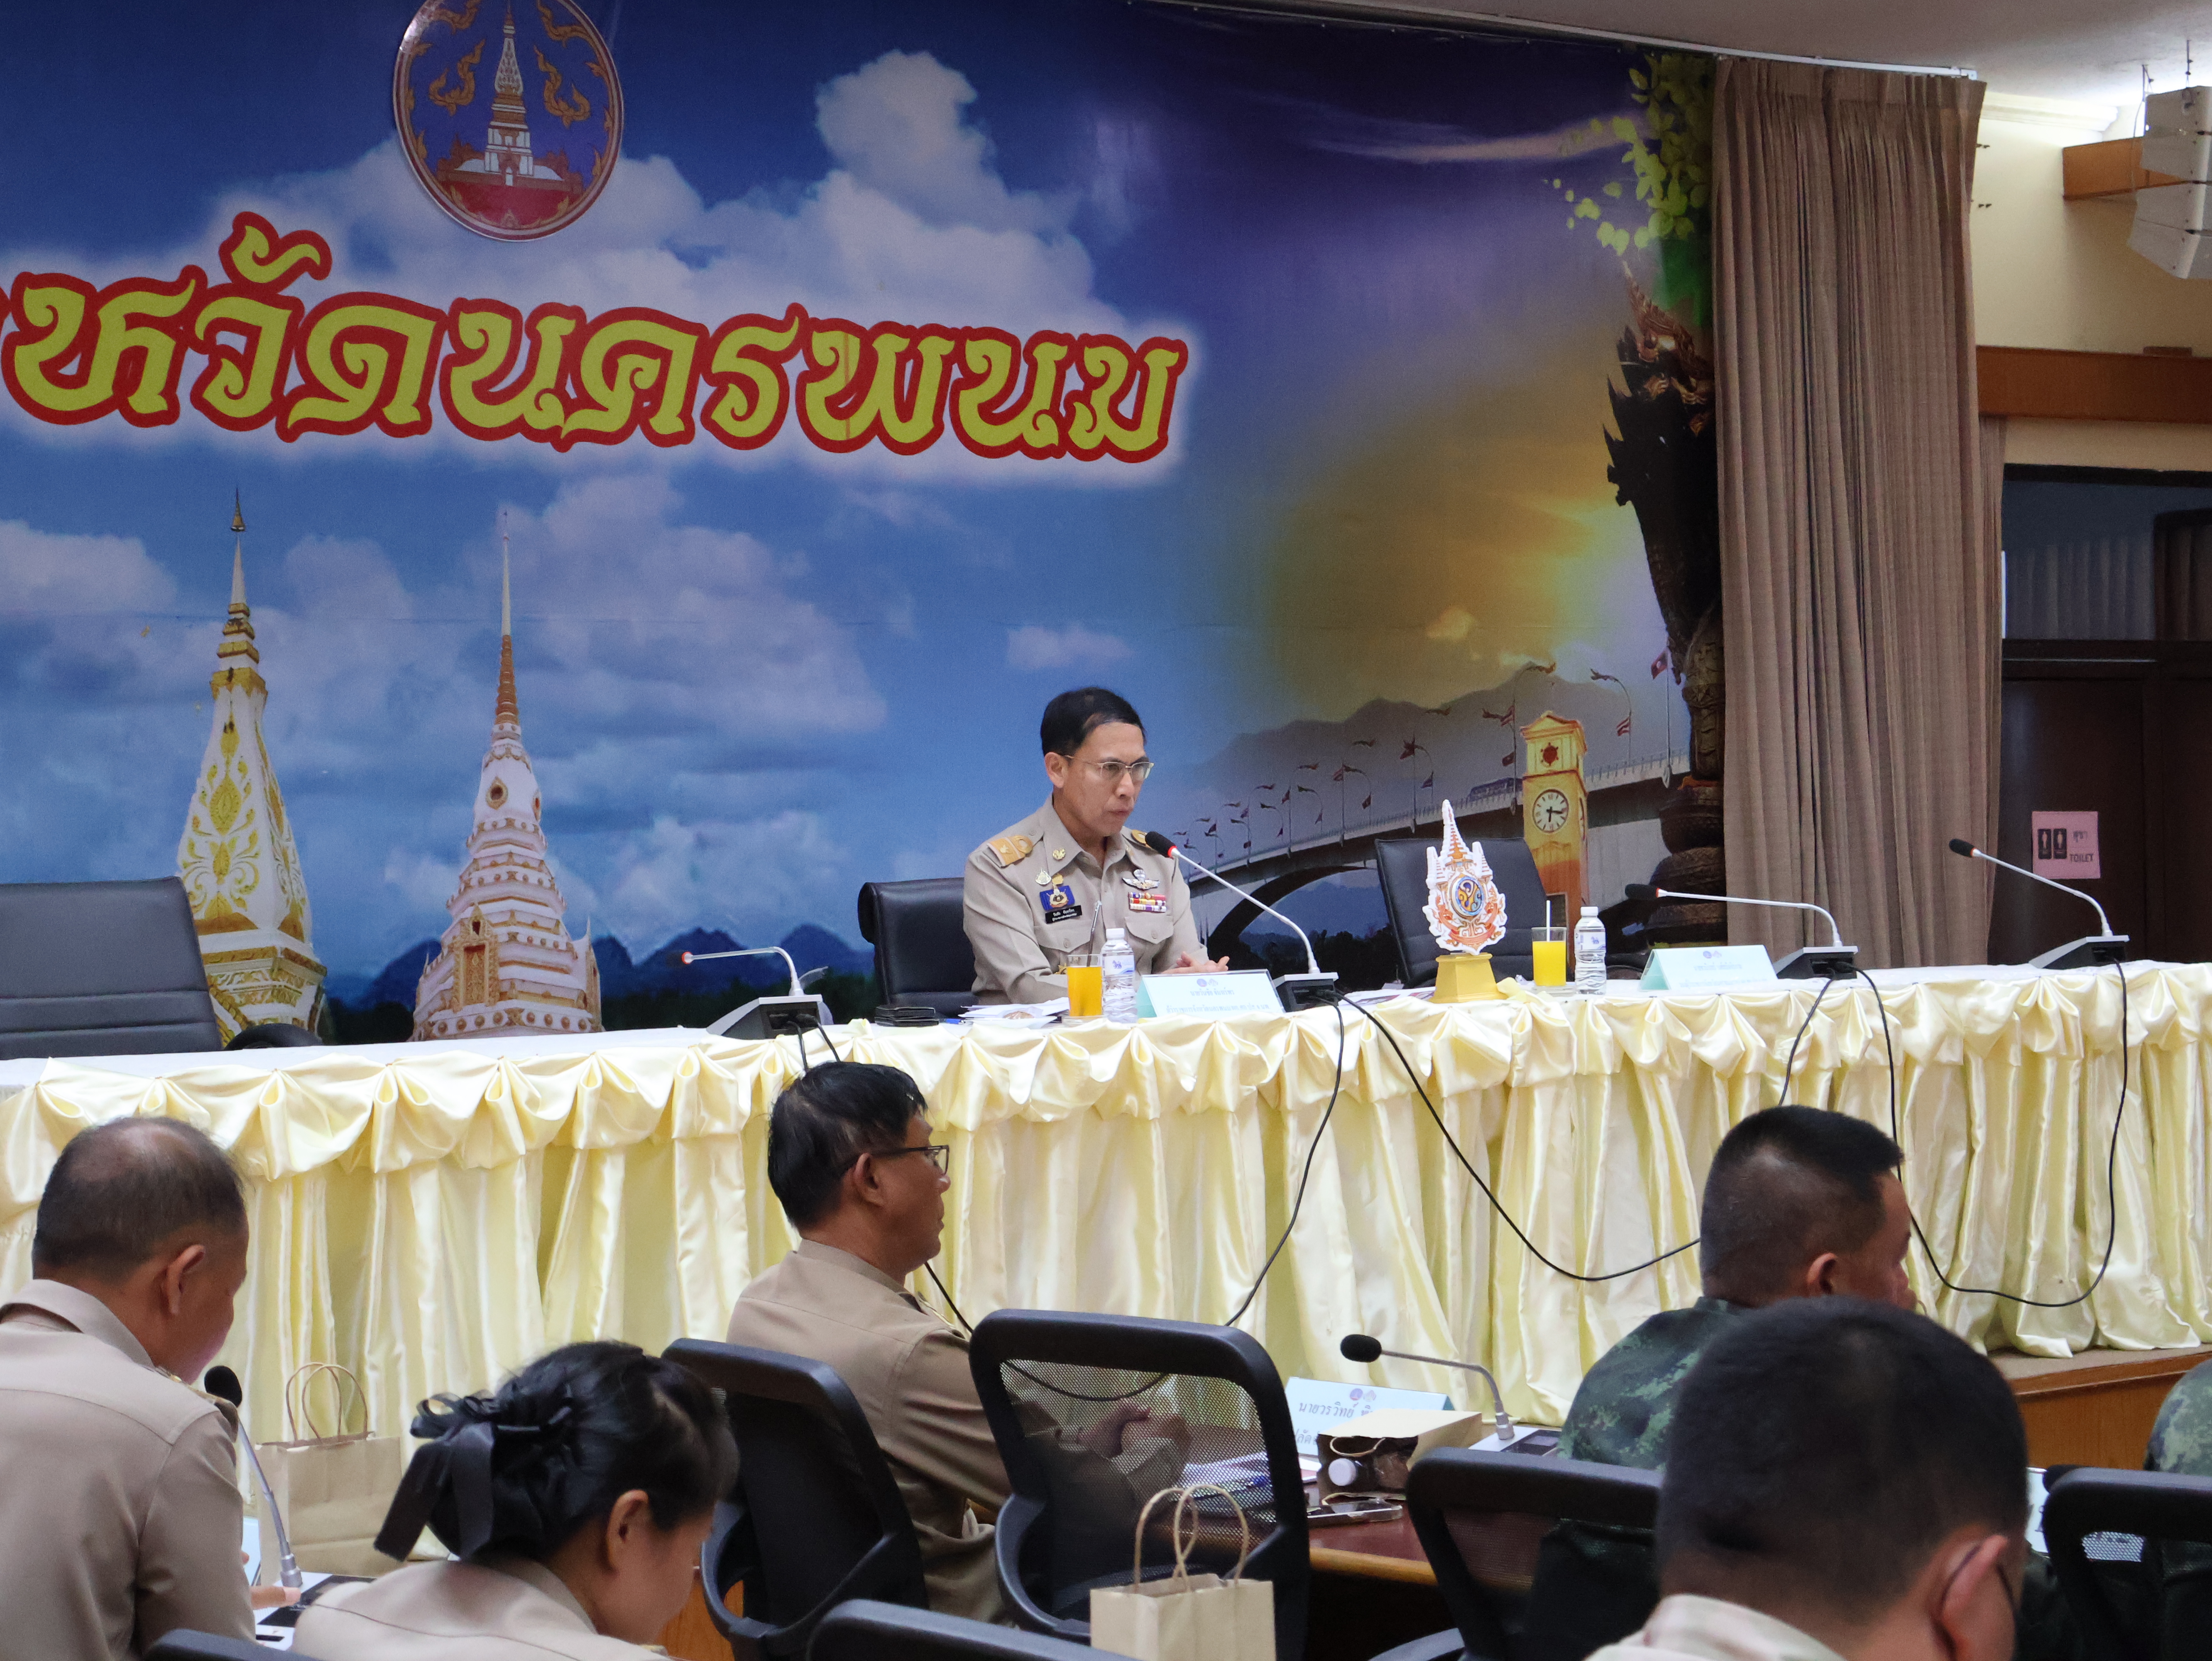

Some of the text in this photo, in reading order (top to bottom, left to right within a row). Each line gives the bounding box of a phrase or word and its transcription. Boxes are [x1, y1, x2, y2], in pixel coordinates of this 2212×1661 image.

[0, 211, 1188, 464] หวัดนครพนม
[2070, 853, 2094, 862] TOILET
[1299, 1401, 1359, 1418] นายวรวิทย์
